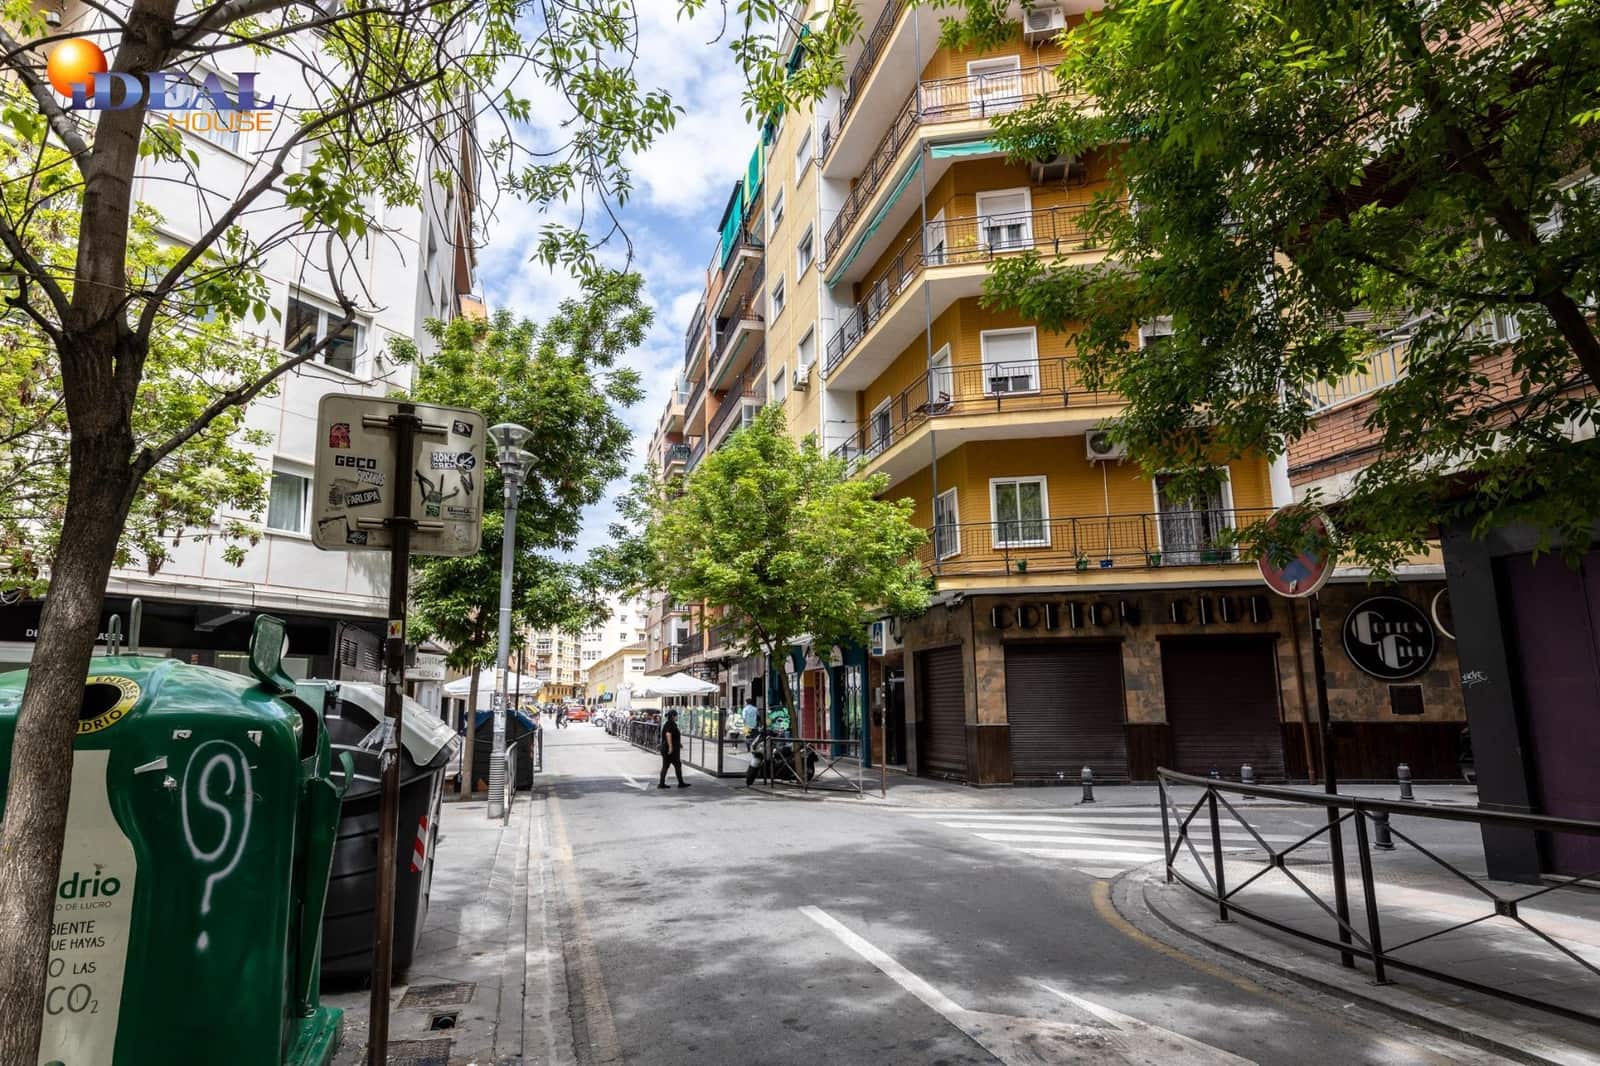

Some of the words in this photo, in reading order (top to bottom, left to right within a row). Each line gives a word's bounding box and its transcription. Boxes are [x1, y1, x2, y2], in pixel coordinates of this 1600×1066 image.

[97, 632, 124, 641] ASER
[78, 709, 123, 733] DRIO
[58, 871, 121, 900] drio
[65, 903, 78, 911] DE
[80, 901, 112, 911] LUCRO
[50, 920, 96, 936] BIENTE
[51, 940, 67, 951] UE
[69, 937, 105, 950] HAYAS
[48, 958, 65, 978] O
[73, 962, 97, 975] LAS
